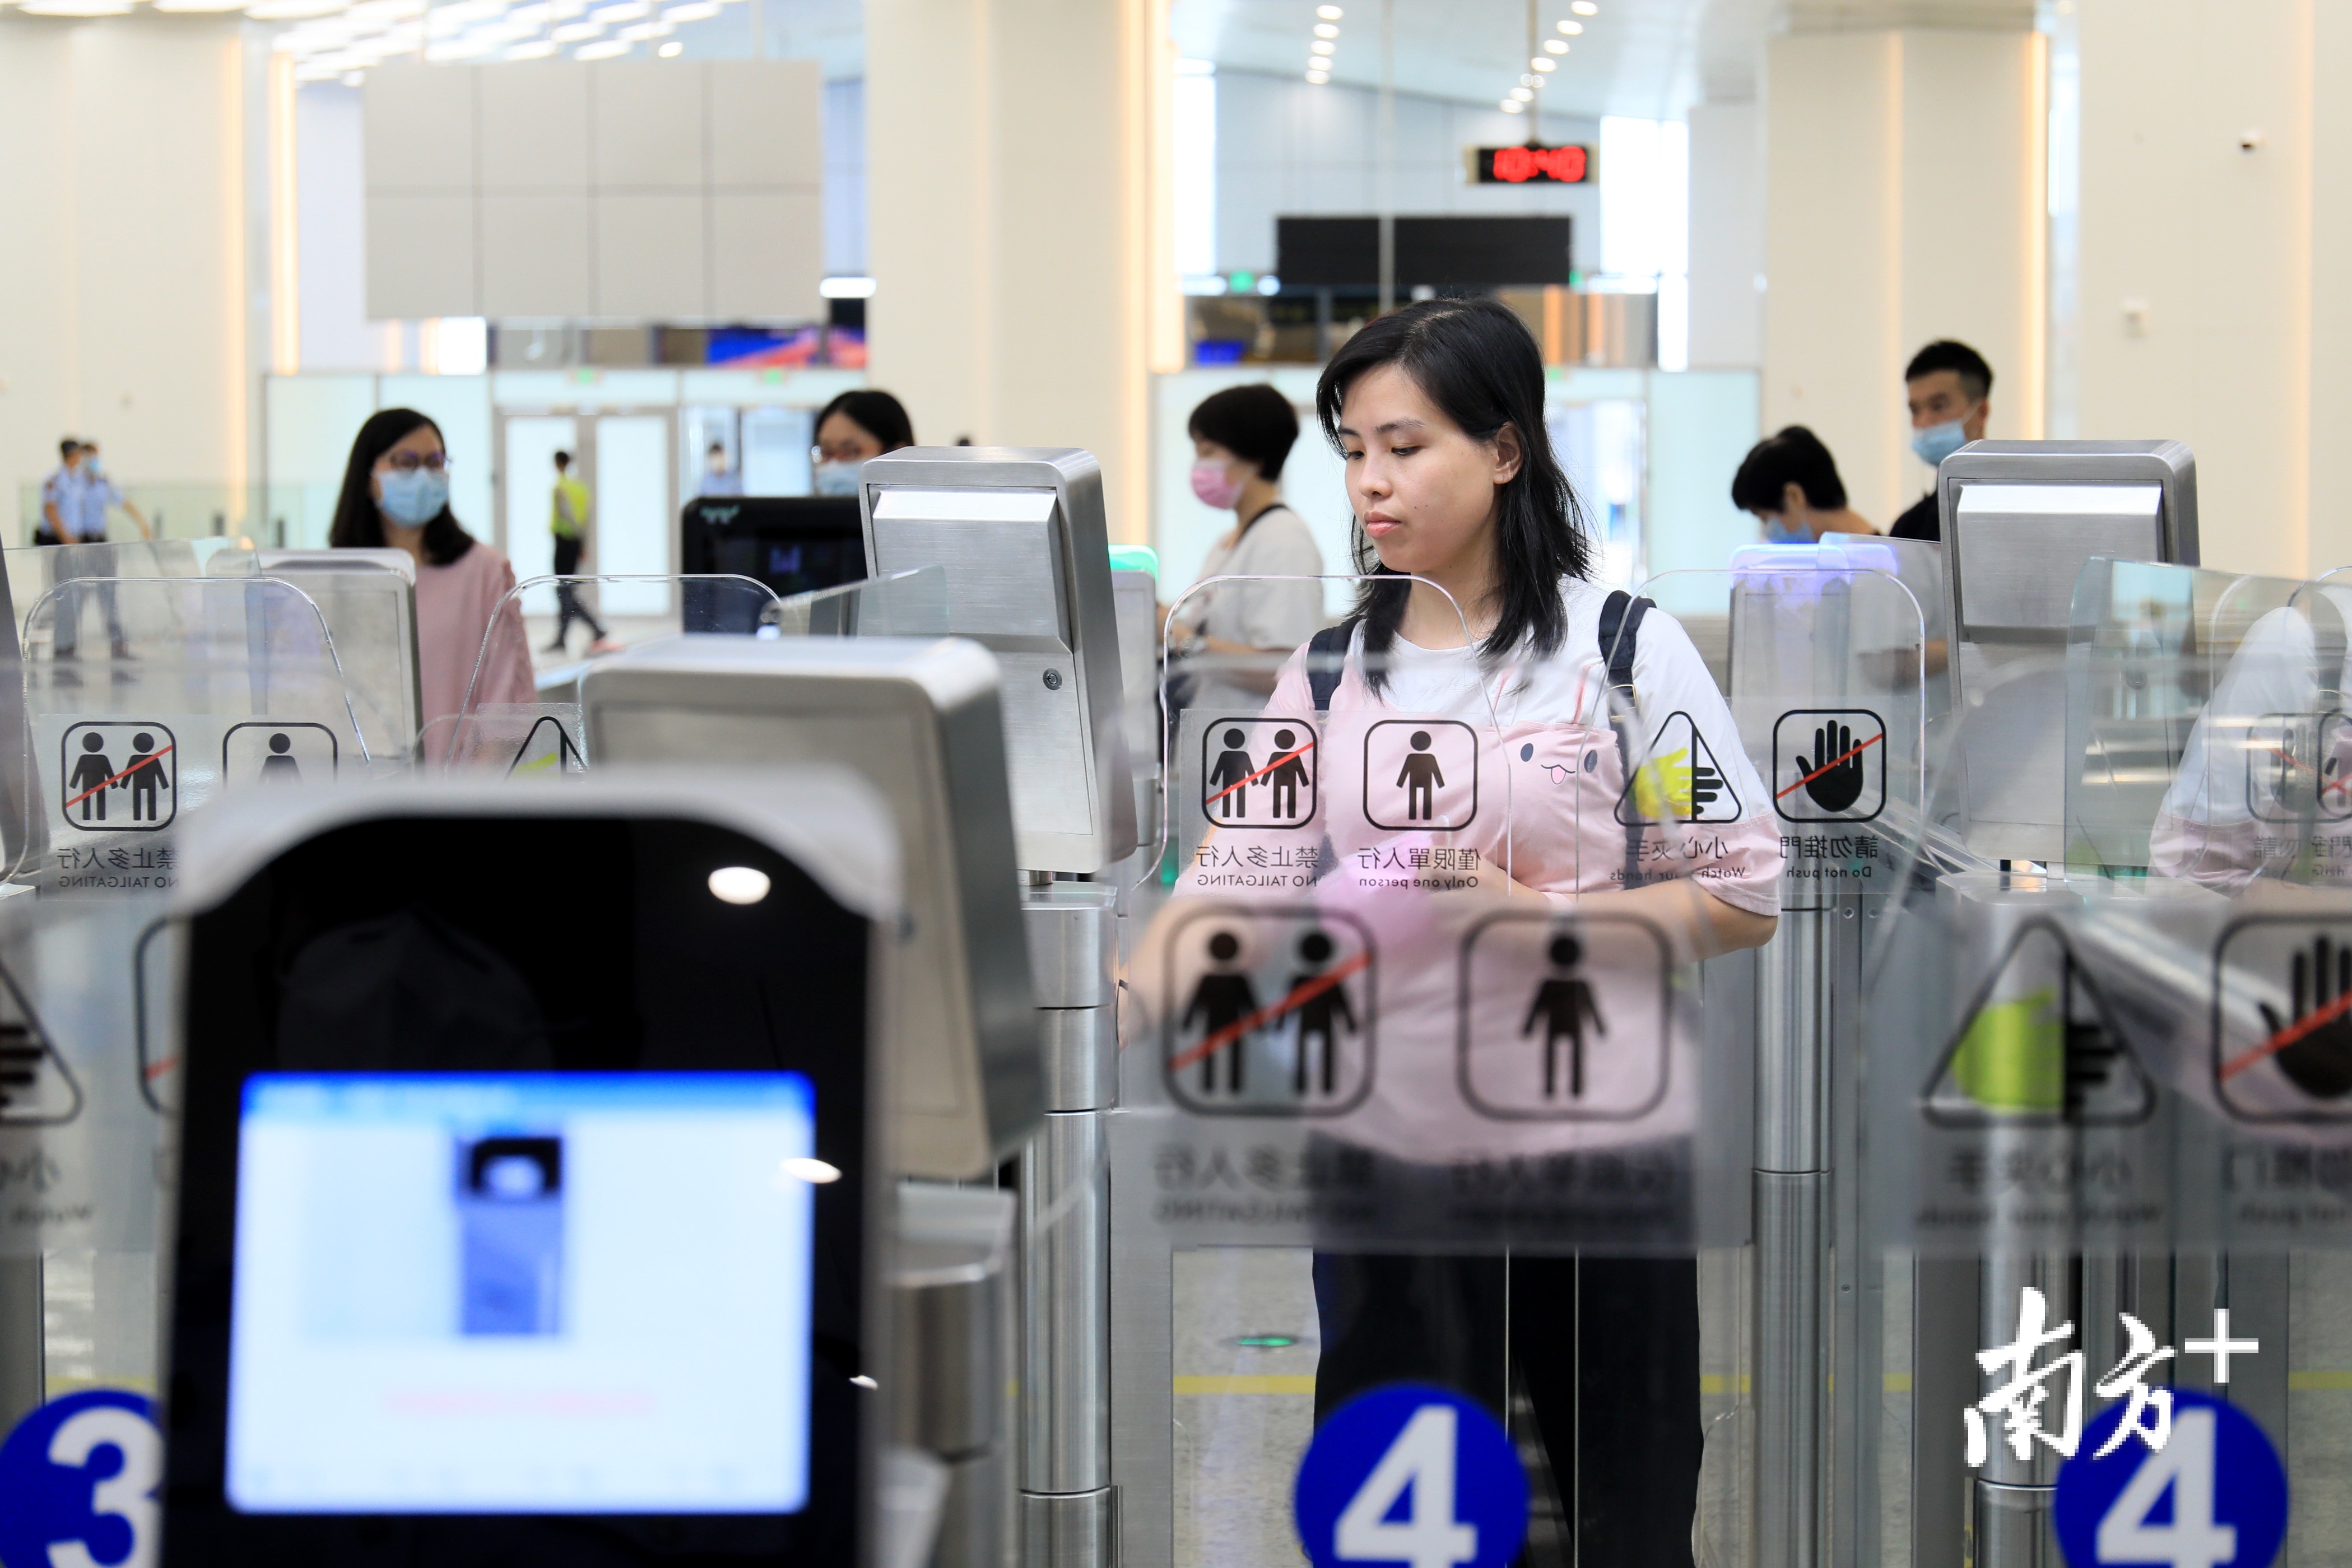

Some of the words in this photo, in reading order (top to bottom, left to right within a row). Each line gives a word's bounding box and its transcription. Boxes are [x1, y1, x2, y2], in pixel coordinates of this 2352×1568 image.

[48, 1406, 165, 1568] 3
[1333, 1405, 1477, 1568] 4
[2096, 1406, 2238, 1568] 4
